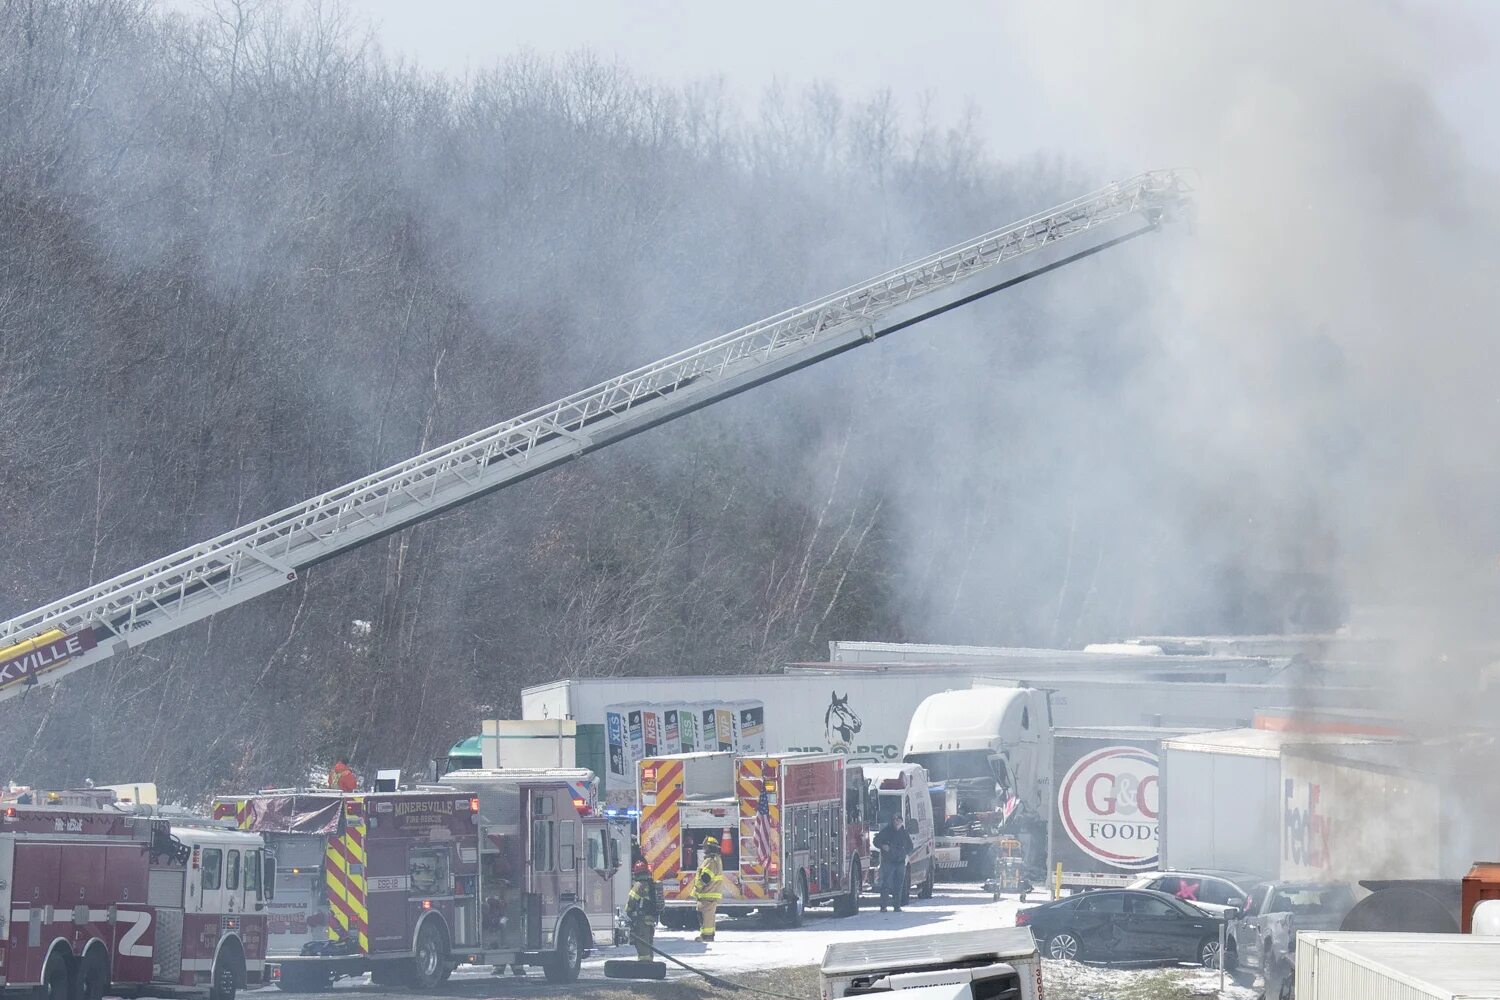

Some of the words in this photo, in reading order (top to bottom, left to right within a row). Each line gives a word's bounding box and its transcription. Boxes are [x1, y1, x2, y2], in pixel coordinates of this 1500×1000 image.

[609, 717, 621, 742] XLS
[646, 718, 656, 740] MS
[683, 719, 693, 737] SS
[395, 800, 453, 816] MINERSVILLE
